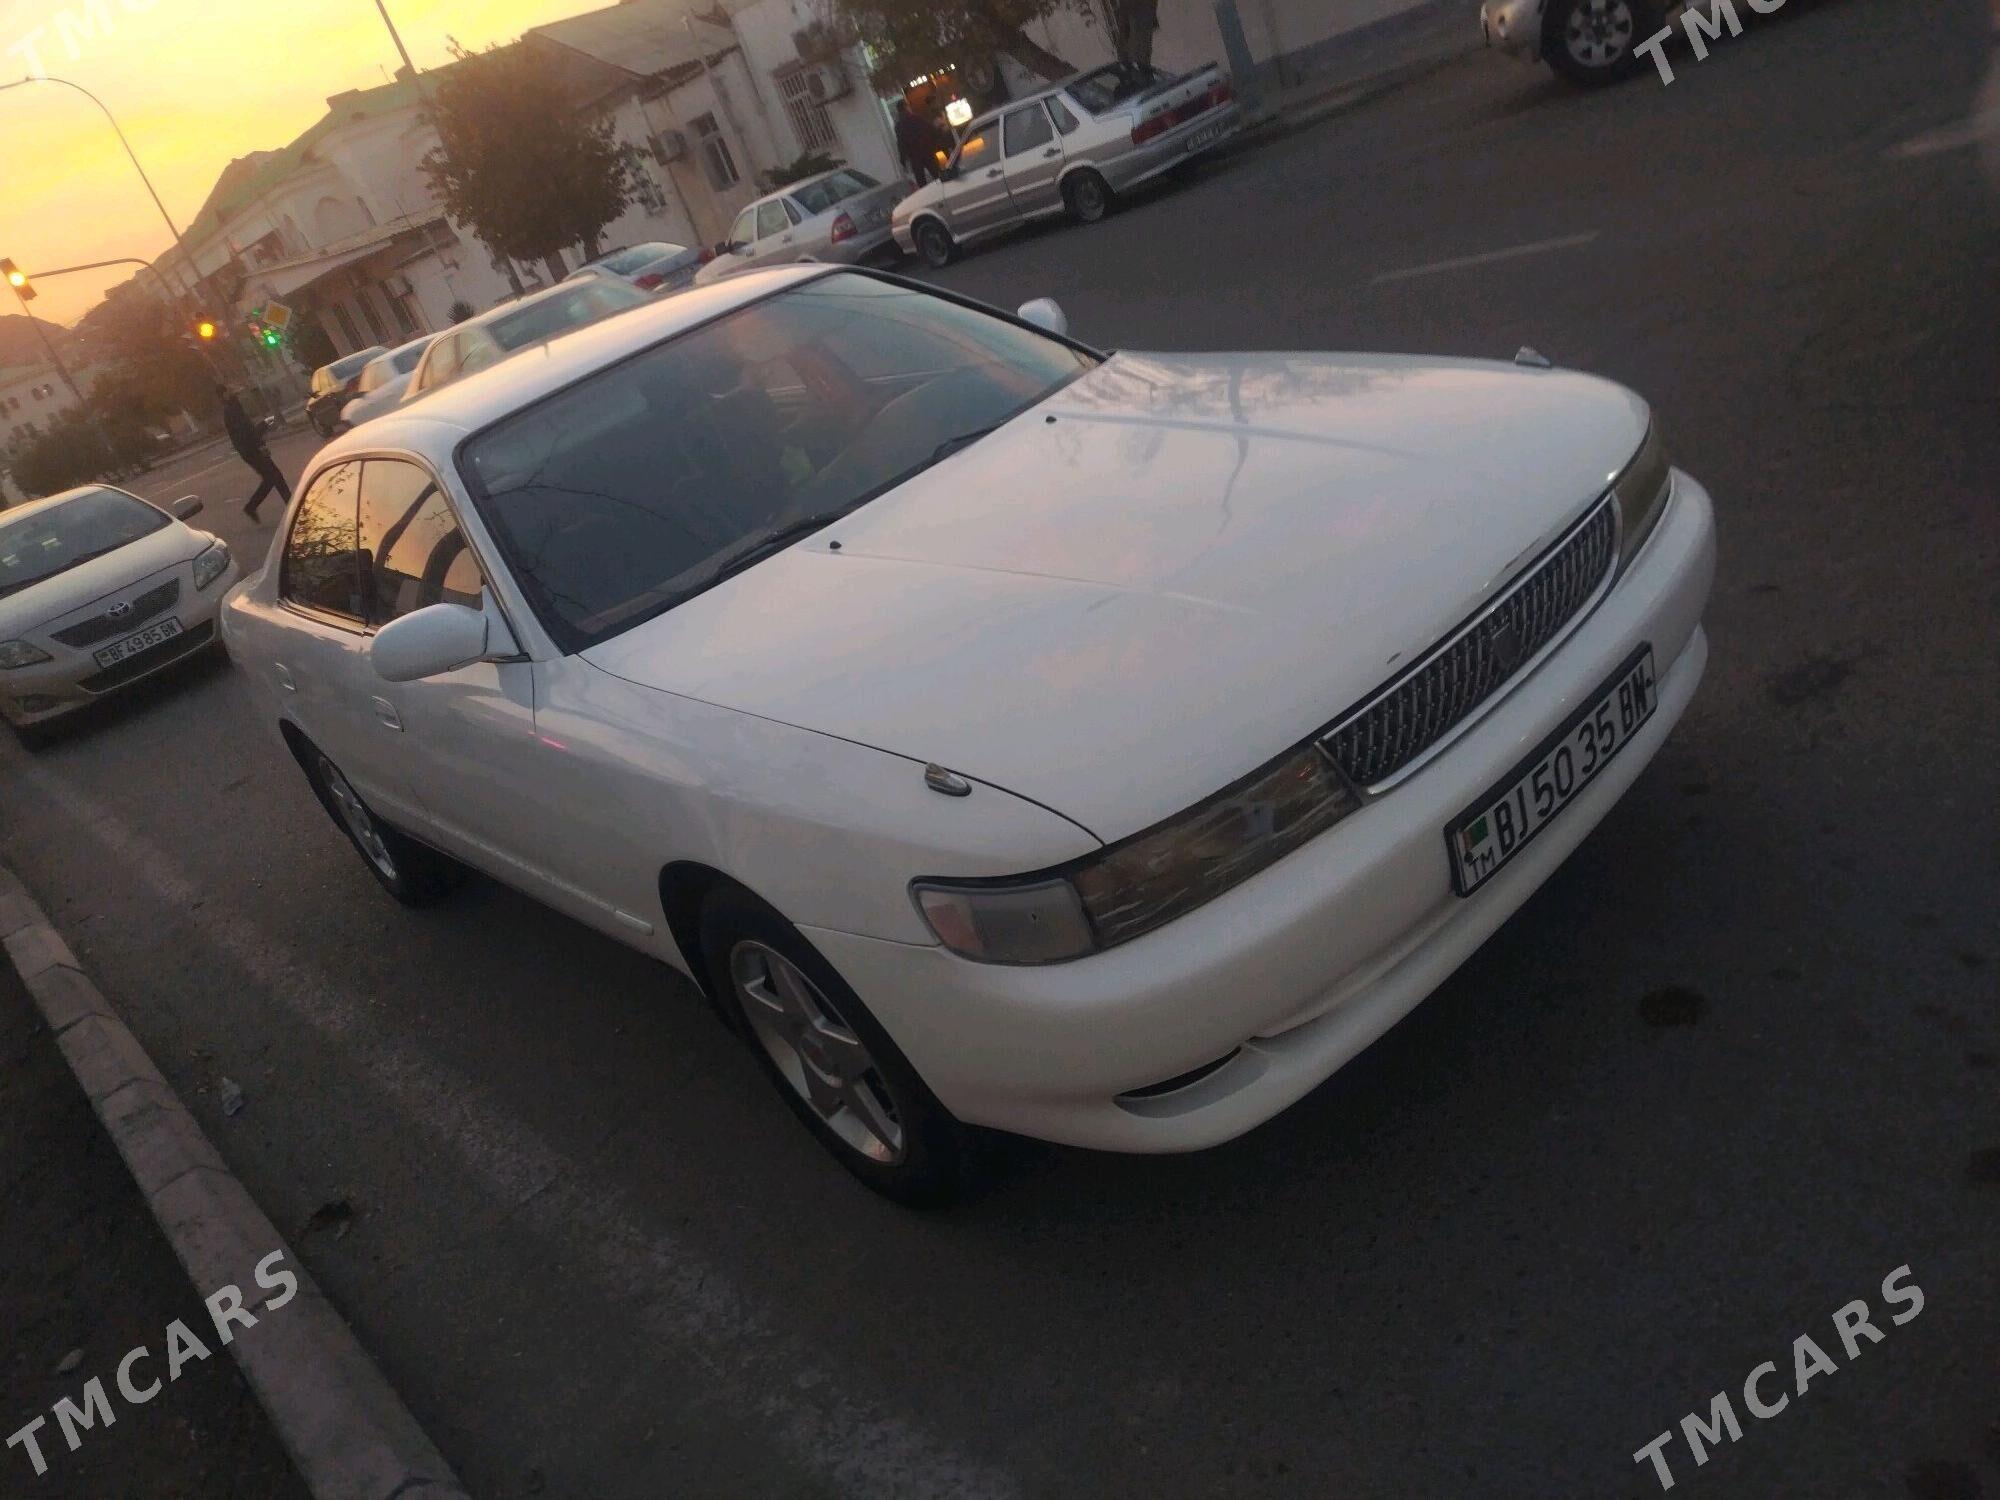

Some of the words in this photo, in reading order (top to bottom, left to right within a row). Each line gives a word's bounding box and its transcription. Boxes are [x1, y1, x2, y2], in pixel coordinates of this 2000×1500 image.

[126, 637, 144, 652] 49
[143, 629, 162, 645] 85
[1493, 785, 1528, 857] BJ
[1532, 746, 1574, 818] 50
[1578, 701, 1615, 774] 35
[1468, 845, 1495, 881] TM
